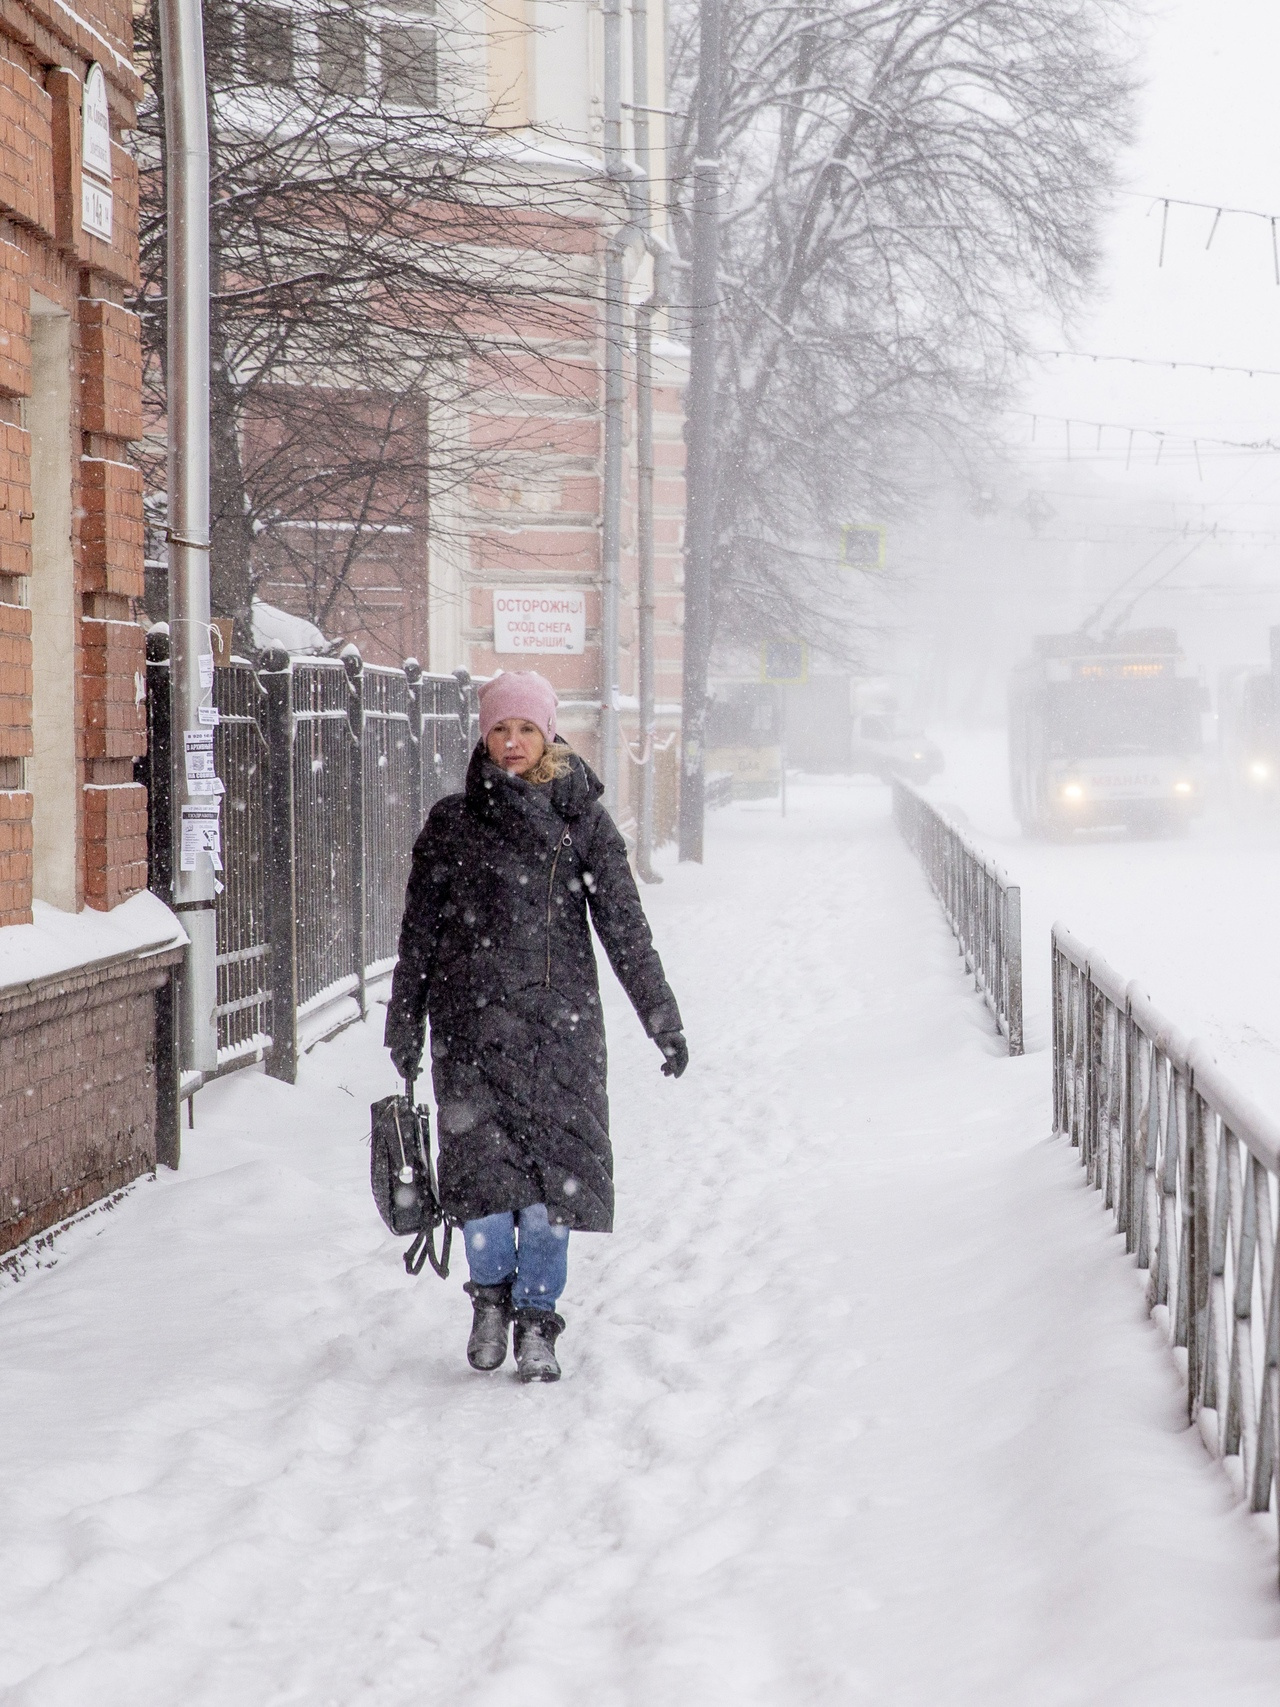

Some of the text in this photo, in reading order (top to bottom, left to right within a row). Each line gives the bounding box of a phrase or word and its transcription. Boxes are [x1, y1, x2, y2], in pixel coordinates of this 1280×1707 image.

[497, 599, 583, 614] ОСТОРОЖНО!
[507, 621, 572, 633] СХОД СНЕГА
[513, 636, 520, 647] С
